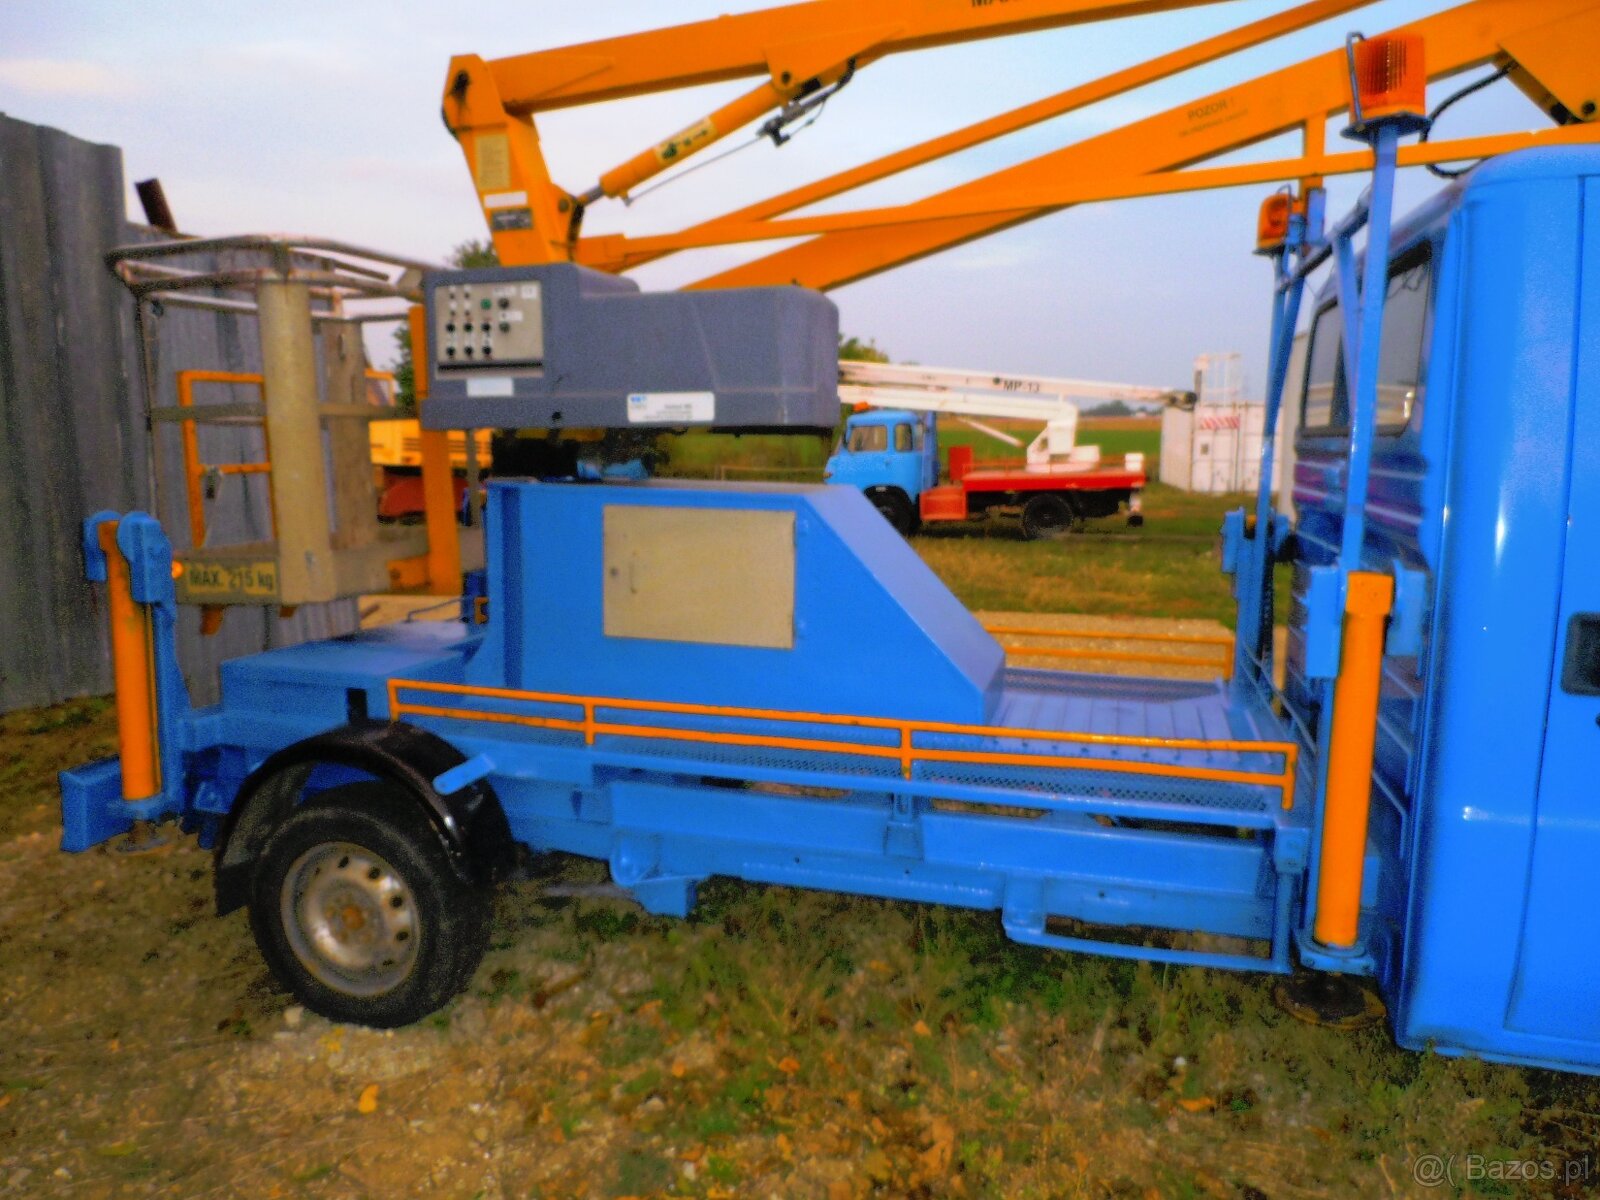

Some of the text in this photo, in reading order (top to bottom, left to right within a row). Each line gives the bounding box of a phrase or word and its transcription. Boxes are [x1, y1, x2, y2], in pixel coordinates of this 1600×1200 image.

[1187, 99, 1228, 121] POZOR
[227, 569, 254, 592] 215
[257, 570, 275, 592] kg
